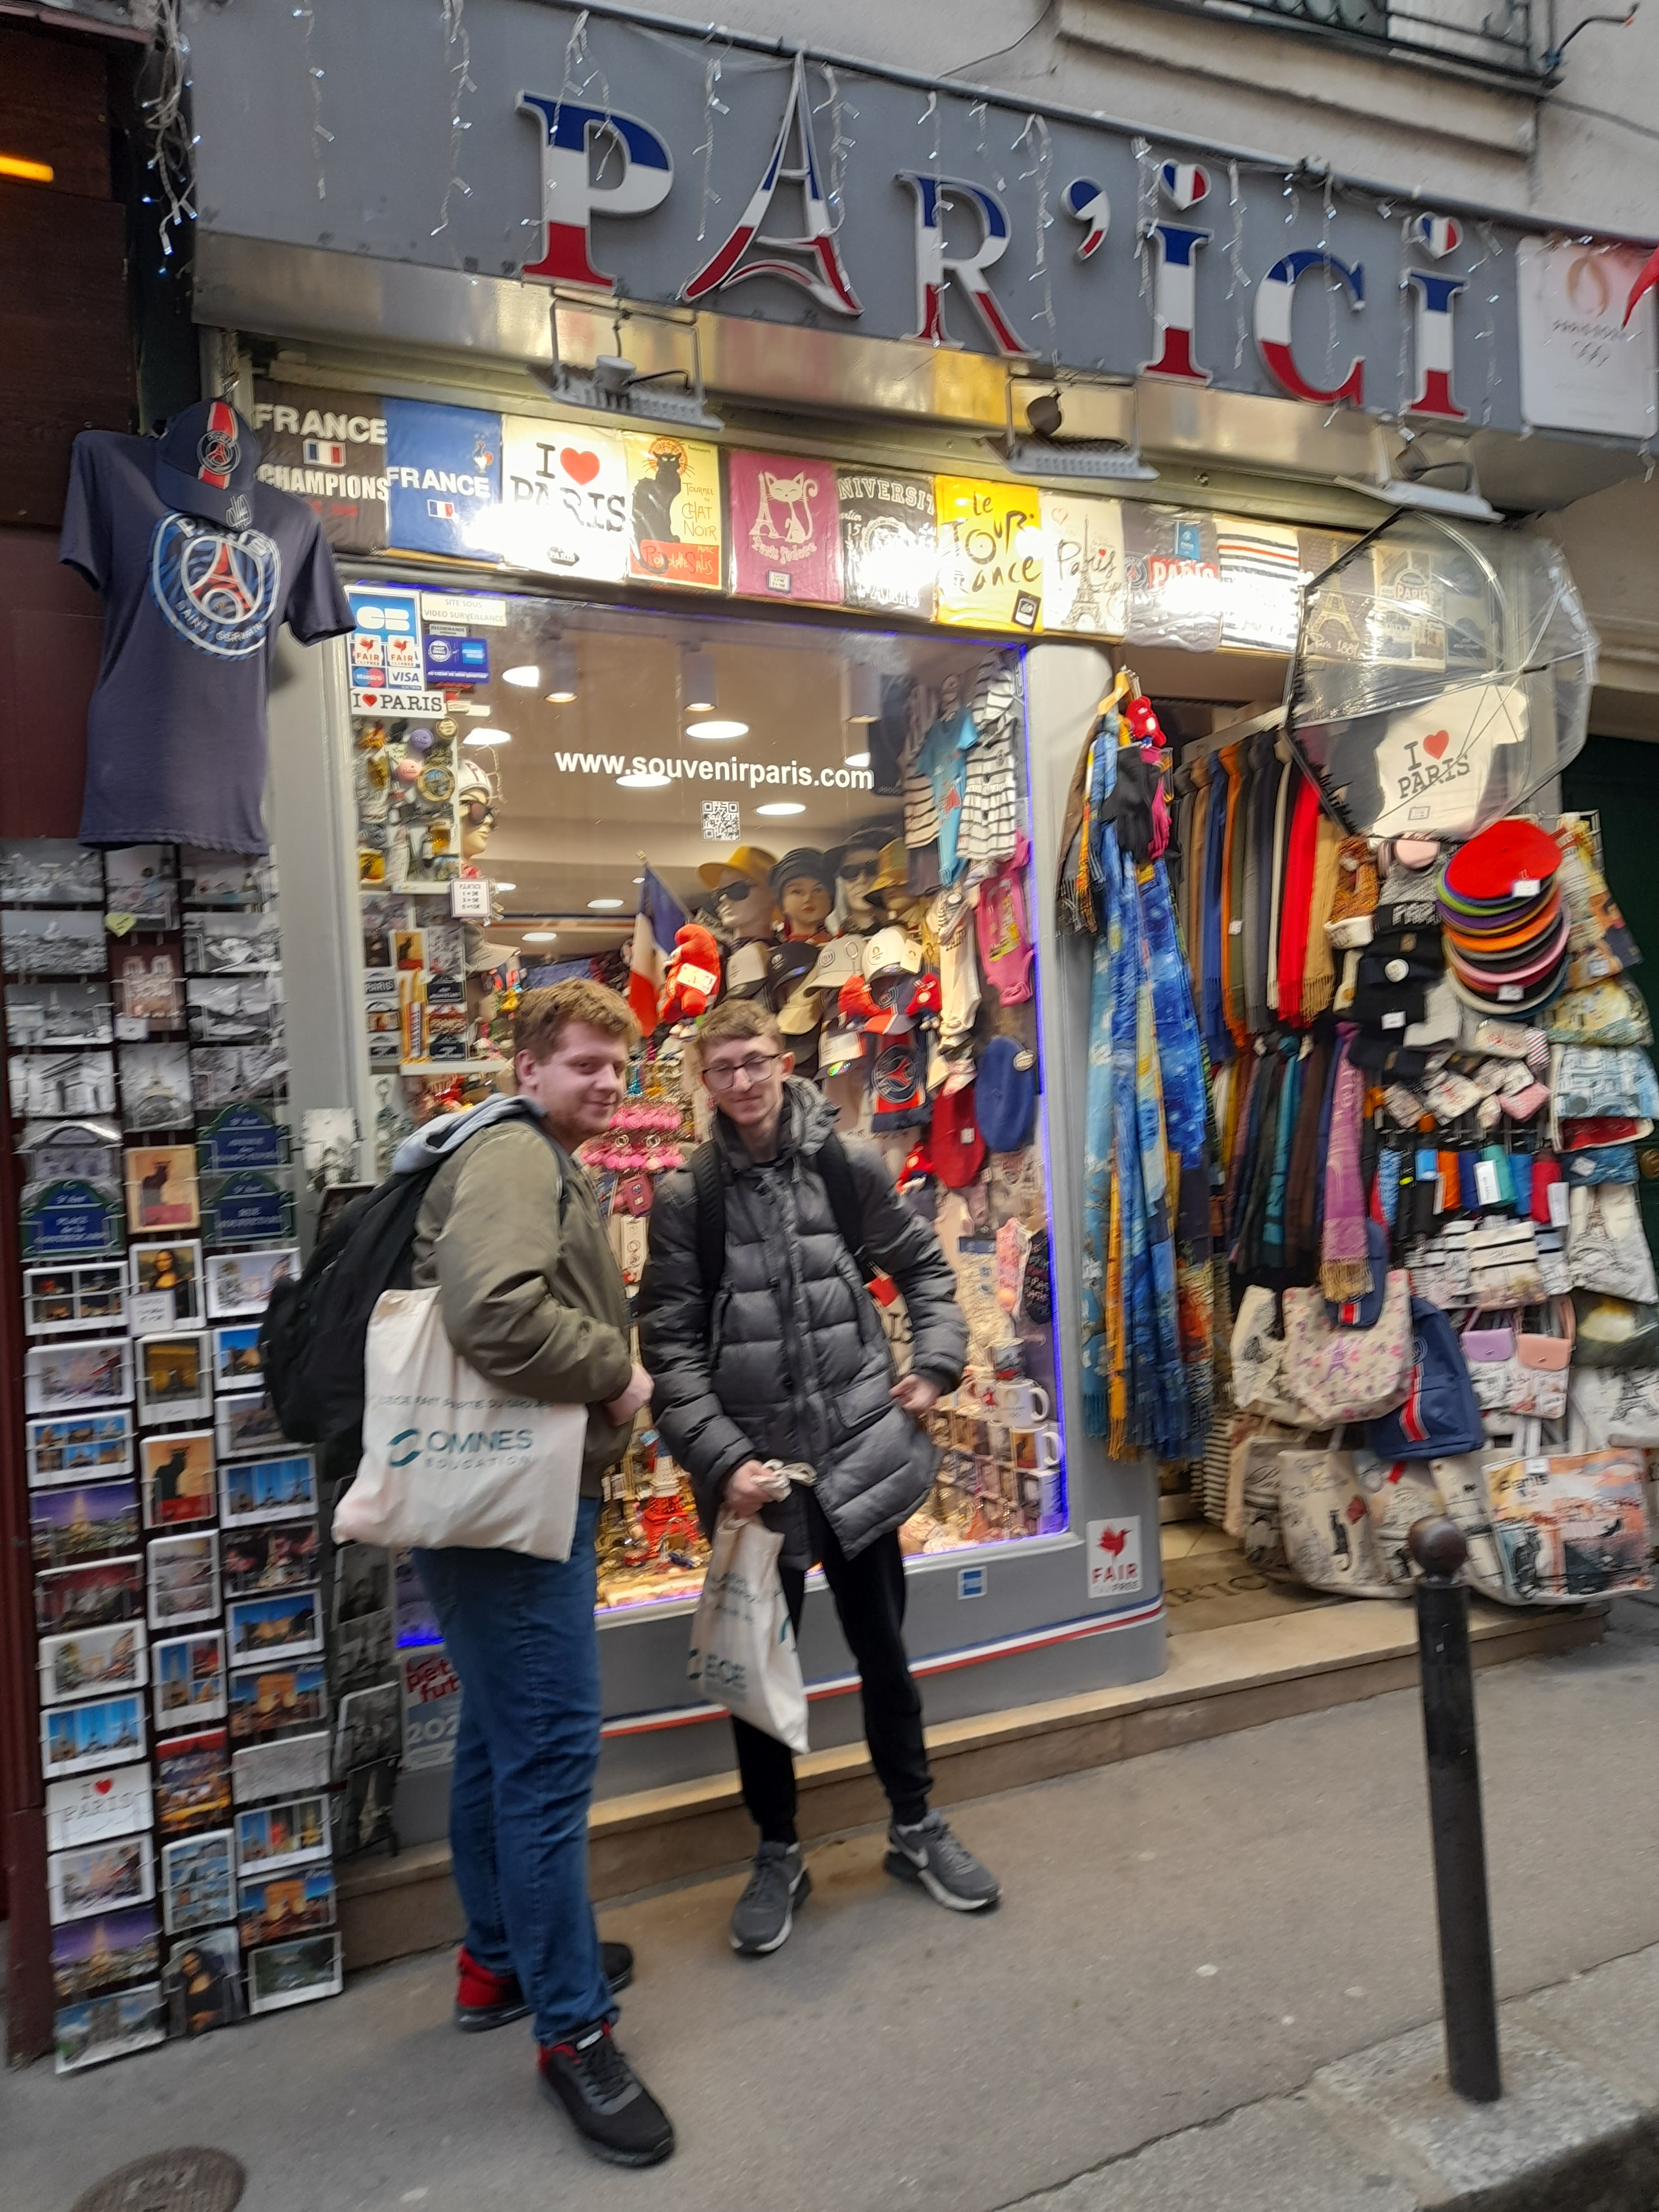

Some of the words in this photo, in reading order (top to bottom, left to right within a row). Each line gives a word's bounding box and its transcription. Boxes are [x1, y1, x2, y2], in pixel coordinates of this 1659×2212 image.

[255, 403, 388, 445] FRANCE
[536, 442, 556, 479] I
[258, 463, 389, 502] CHAMPIONS
[386, 466, 492, 499] FRANCE
[682, 502, 713, 523] CHAT
[684, 520, 717, 541] NOIR
[445, 598, 461, 607] SITE
[462, 600, 483, 608] SOUS
[424, 609, 448, 618] VIDEO
[450, 611, 504, 623] SURVEILLANCE
[357, 653, 380, 661] FAIR
[391, 654, 414, 662] FAIR
[393, 671, 420, 682] VISA
[353, 693, 361, 708] I
[379, 695, 442, 712] PARIS
[1404, 740, 1423, 772] I
[555, 752, 874, 790] www.souvenirparis.com
[1397, 753, 1471, 800] PARIS
[427, 1428, 535, 1454] OMNES
[1092, 1562, 1138, 1584] FAIR
